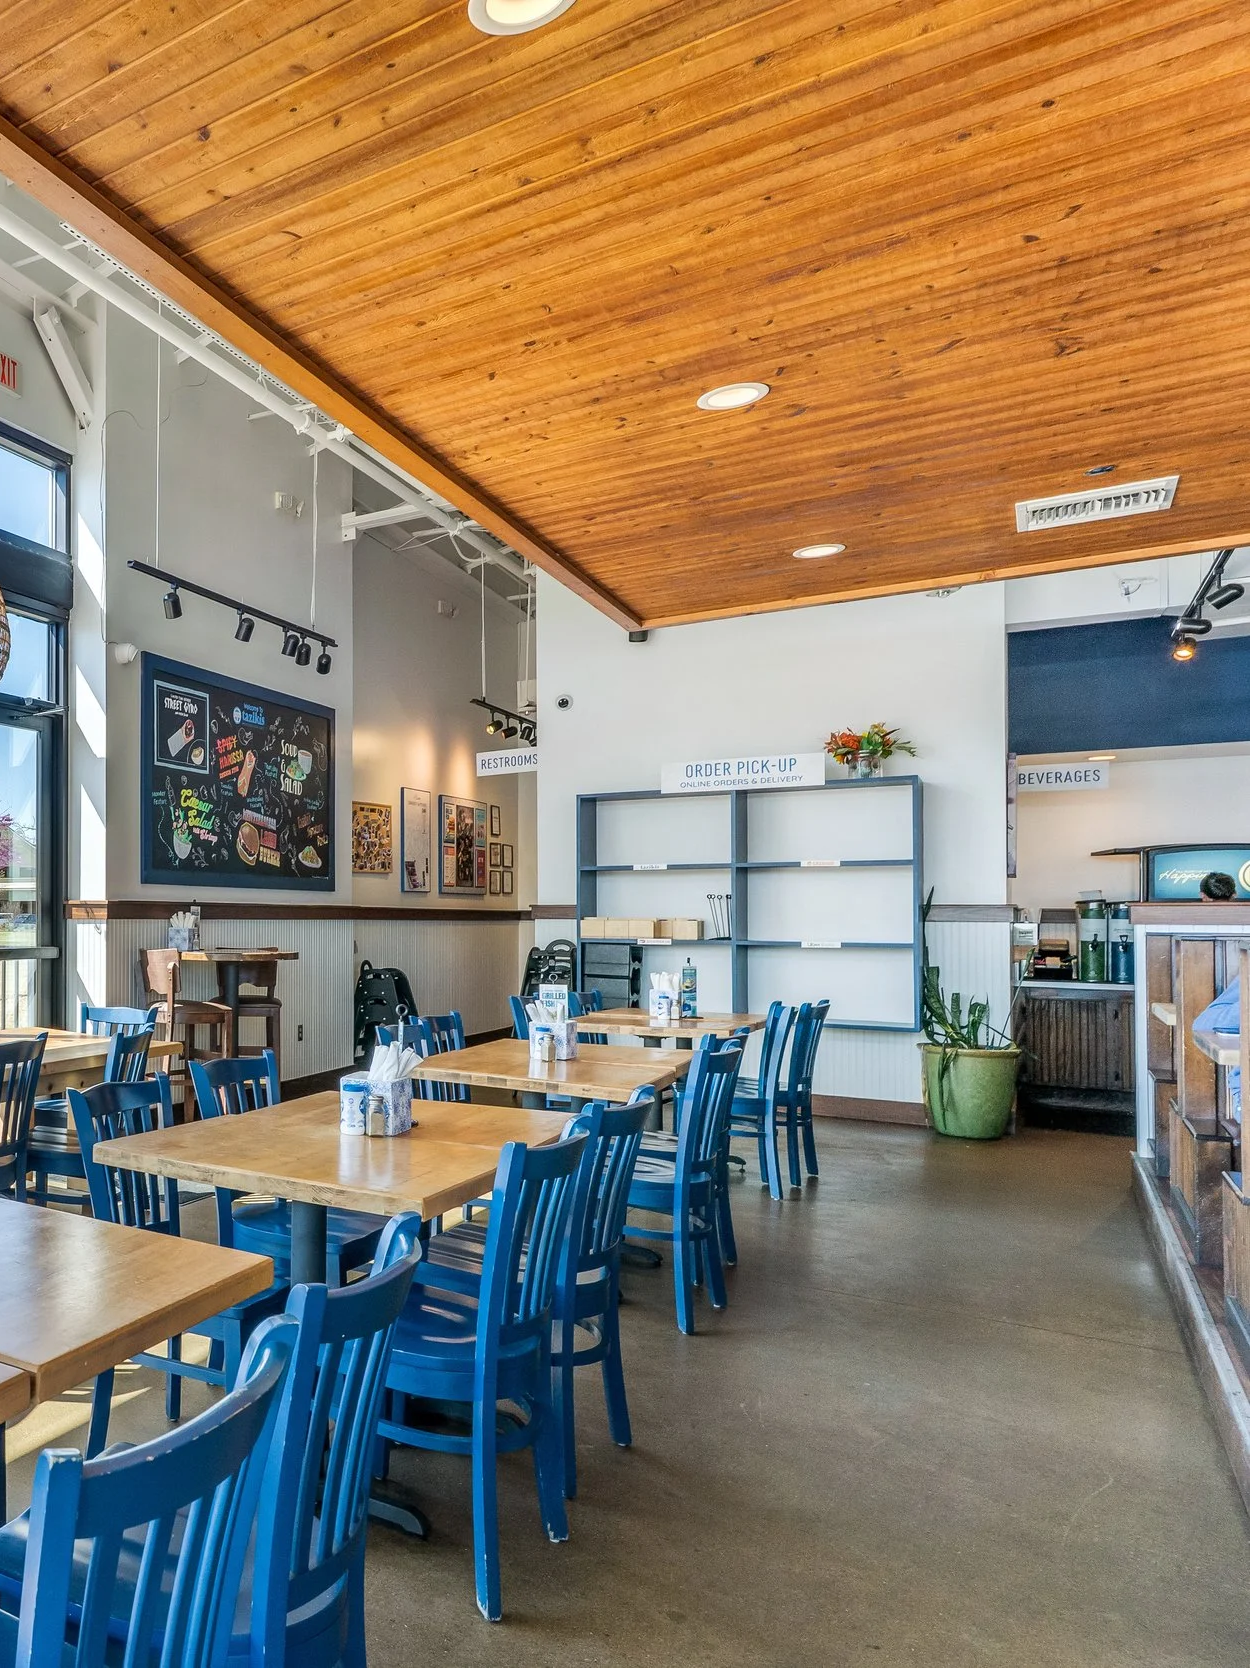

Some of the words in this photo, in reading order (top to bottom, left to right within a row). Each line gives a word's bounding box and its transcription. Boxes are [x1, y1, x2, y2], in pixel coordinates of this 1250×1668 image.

[164, 697, 183, 711] STREET
[481, 754, 538, 770] RESTROOMS
[685, 762, 732, 778] ORDER
[737, 757, 797, 776] PICK-UP
[713, 778, 749, 787] ORDERS
[760, 775, 804, 784] DELIVERY
[1018, 769, 1101, 785] BEVERAGES
[542, 992, 566, 1000] GRILLED
